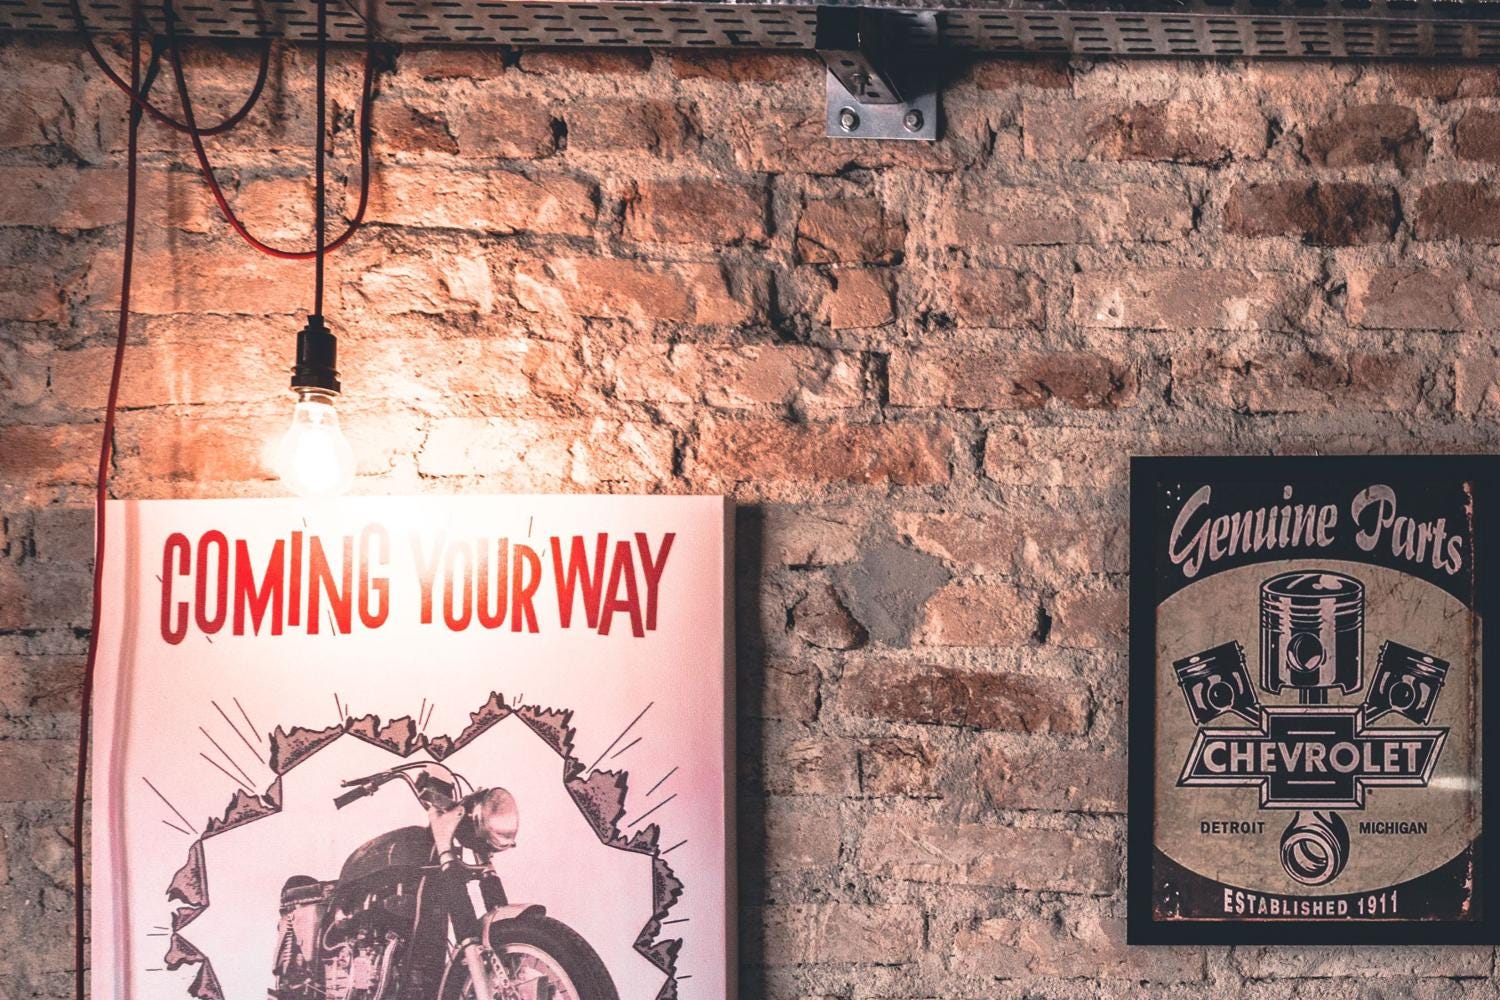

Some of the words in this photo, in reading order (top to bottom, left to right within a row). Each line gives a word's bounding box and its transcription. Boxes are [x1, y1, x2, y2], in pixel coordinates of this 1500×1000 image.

[1168, 484, 1338, 578] Genuine
[1351, 484, 1463, 575] Parts
[161, 522, 390, 645] COMING
[408, 531, 542, 633] YOUR
[549, 532, 676, 638] WAY
[1201, 741, 1423, 775] CHEVROLET
[1200, 821, 1265, 835] DETROIT
[1358, 821, 1428, 835] MICHIGAN
[1223, 887, 1349, 916] ESTABLISHED
[1357, 890, 1398, 915] 1911
